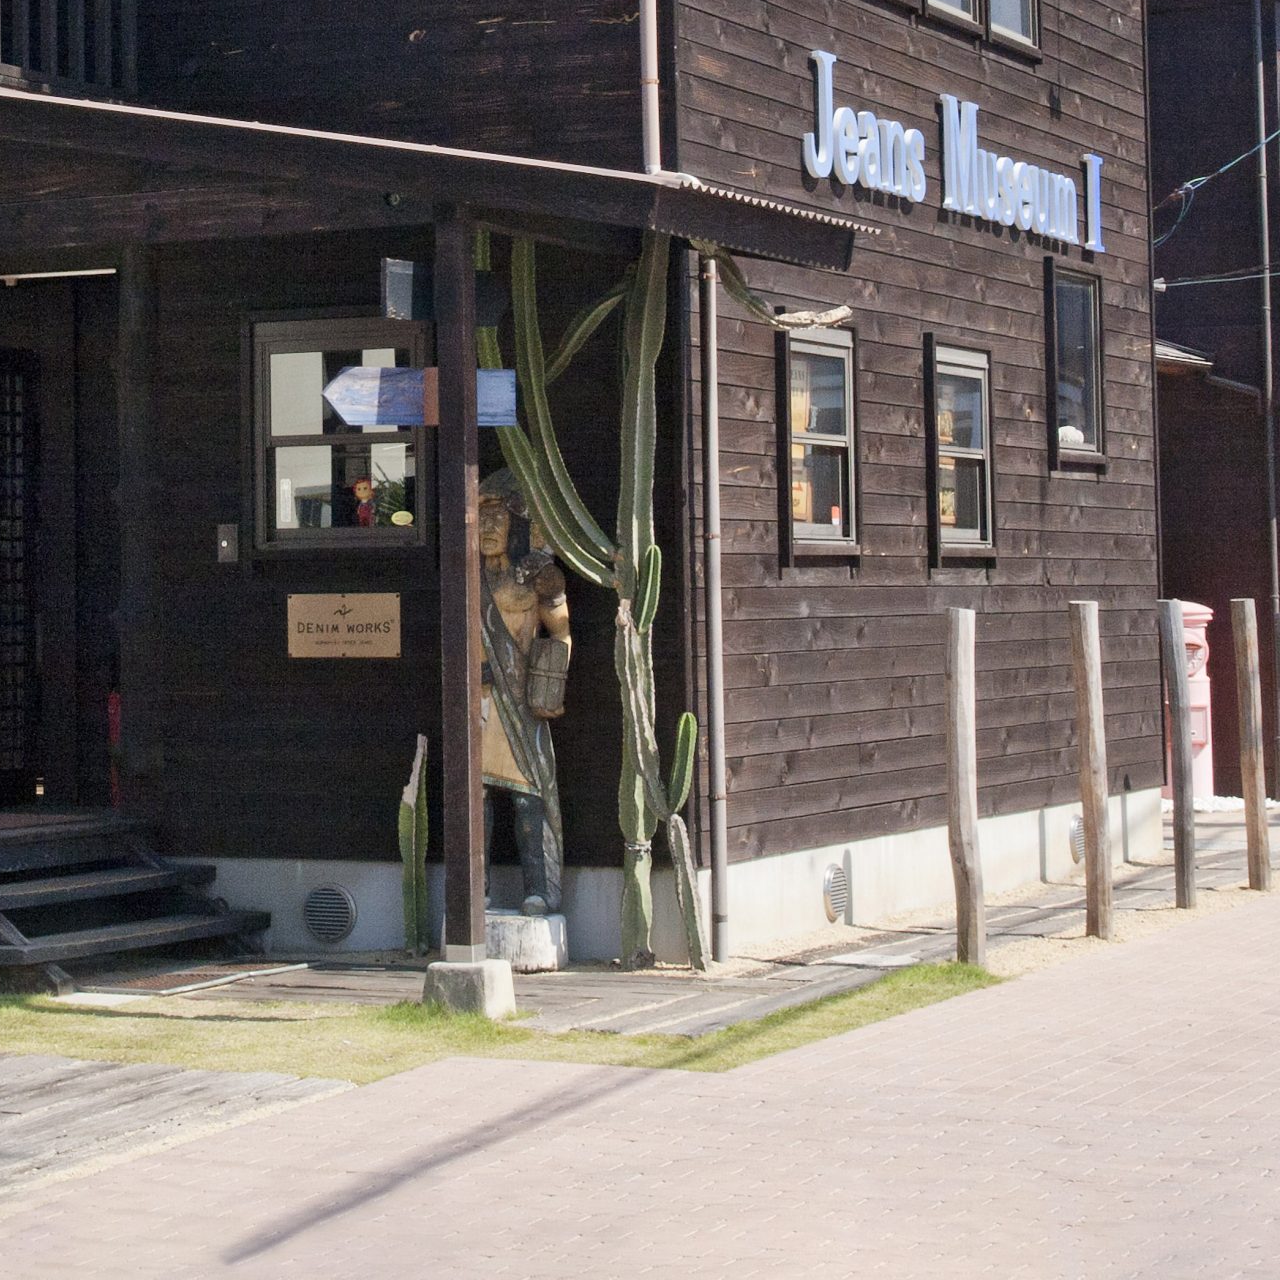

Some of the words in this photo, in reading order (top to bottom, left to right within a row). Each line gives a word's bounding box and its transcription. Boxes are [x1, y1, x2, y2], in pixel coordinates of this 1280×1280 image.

[803, 50, 925, 203] Jeans
[940, 93, 1078, 245] Museum
[297, 622, 340, 634] DENIM
[346, 621, 391, 634] WORKS
